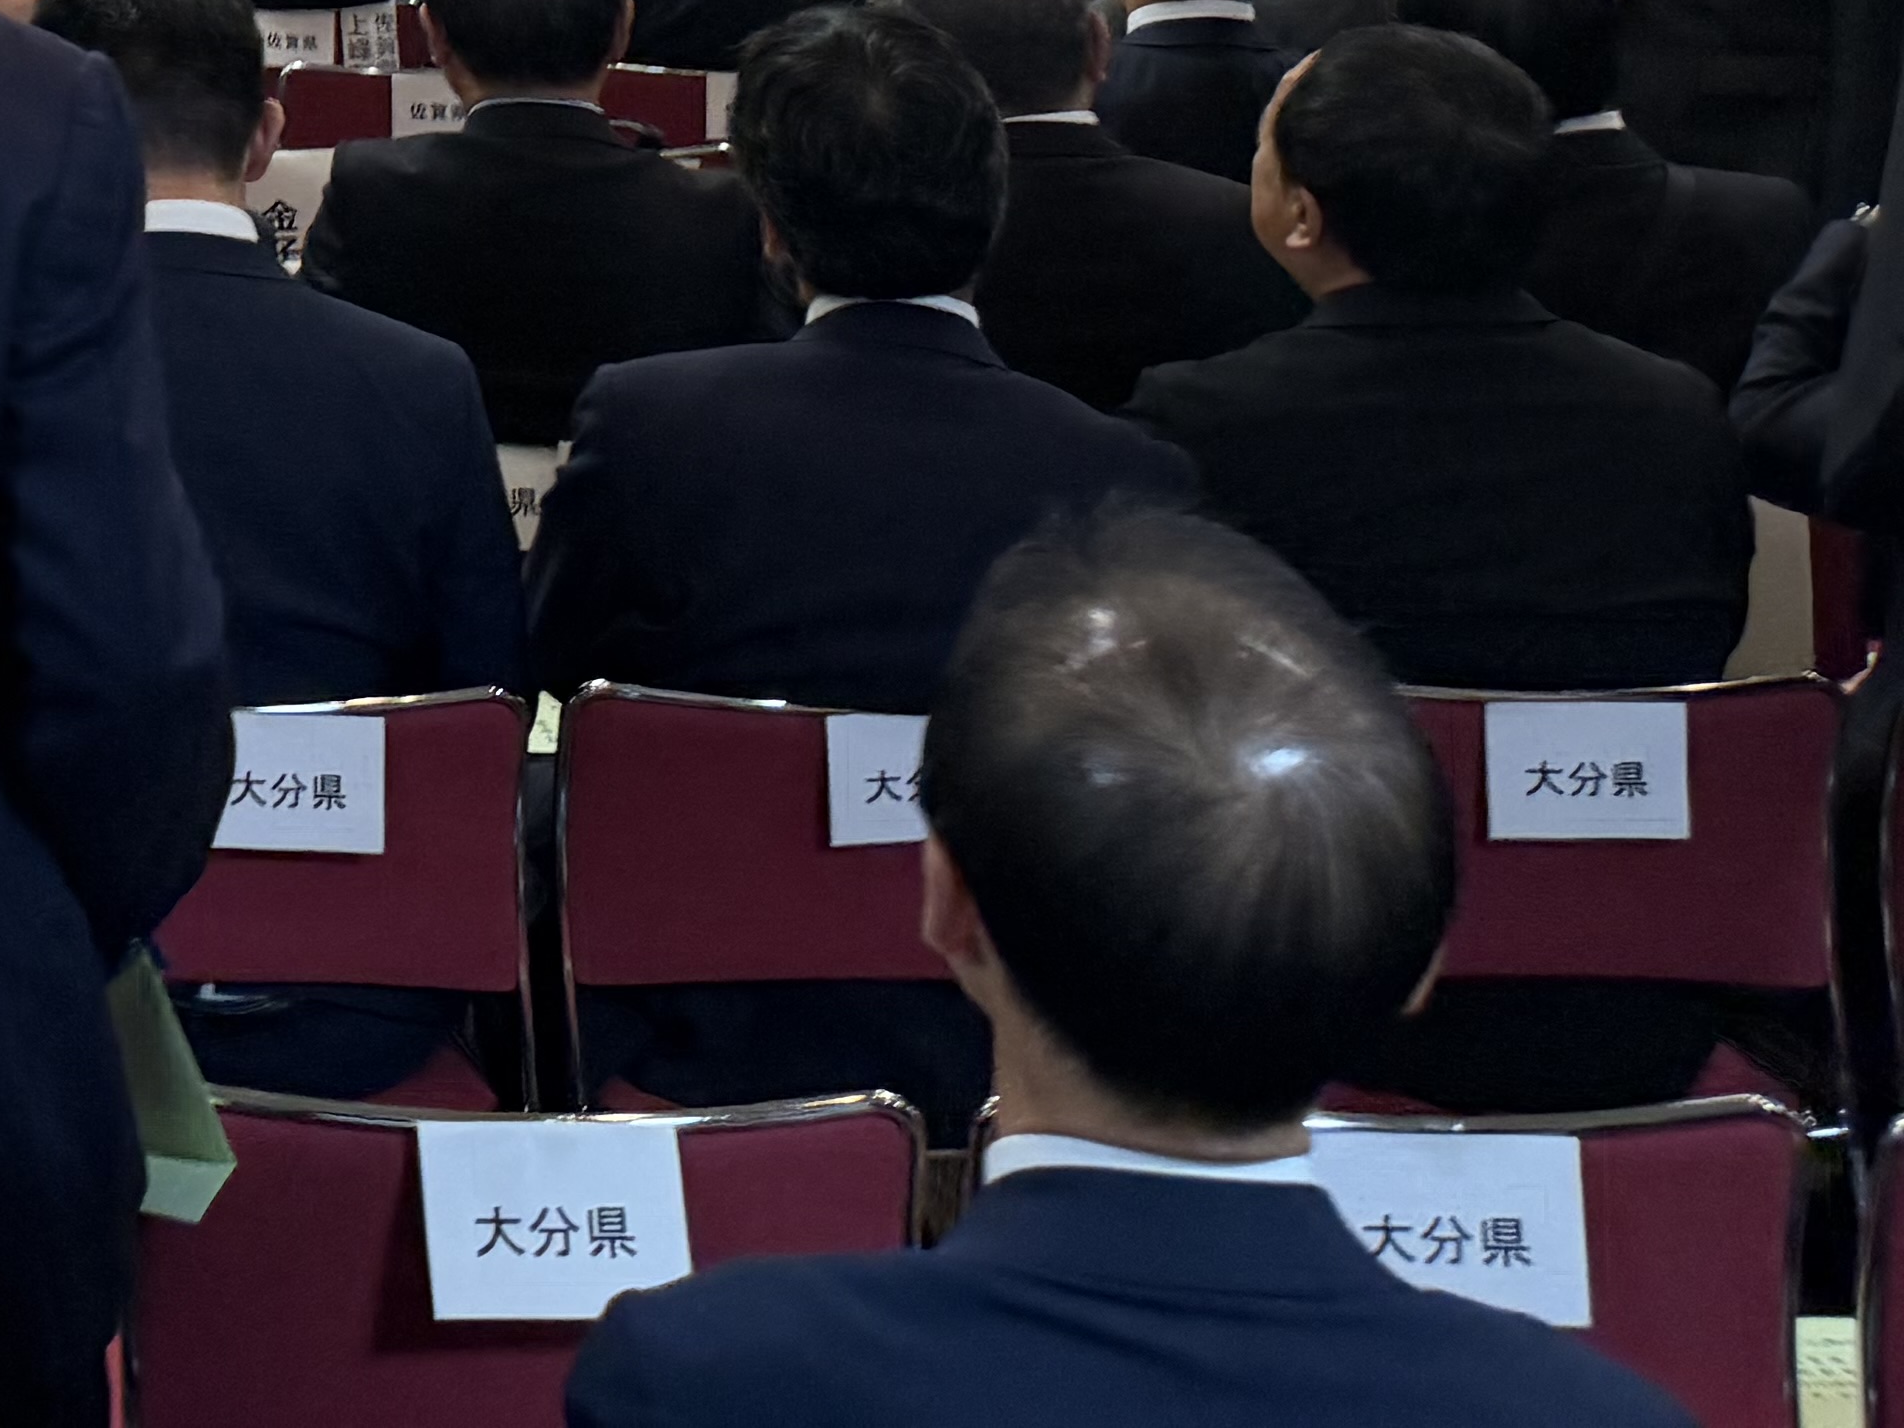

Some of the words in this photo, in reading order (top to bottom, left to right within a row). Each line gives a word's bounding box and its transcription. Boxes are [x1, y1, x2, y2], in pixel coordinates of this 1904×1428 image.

[230, 771, 348, 811] 大分県
[1524, 760, 1650, 800] 大分県
[475, 1205, 638, 1259] 大分県
[1362, 1215, 1533, 1268] 大分県
